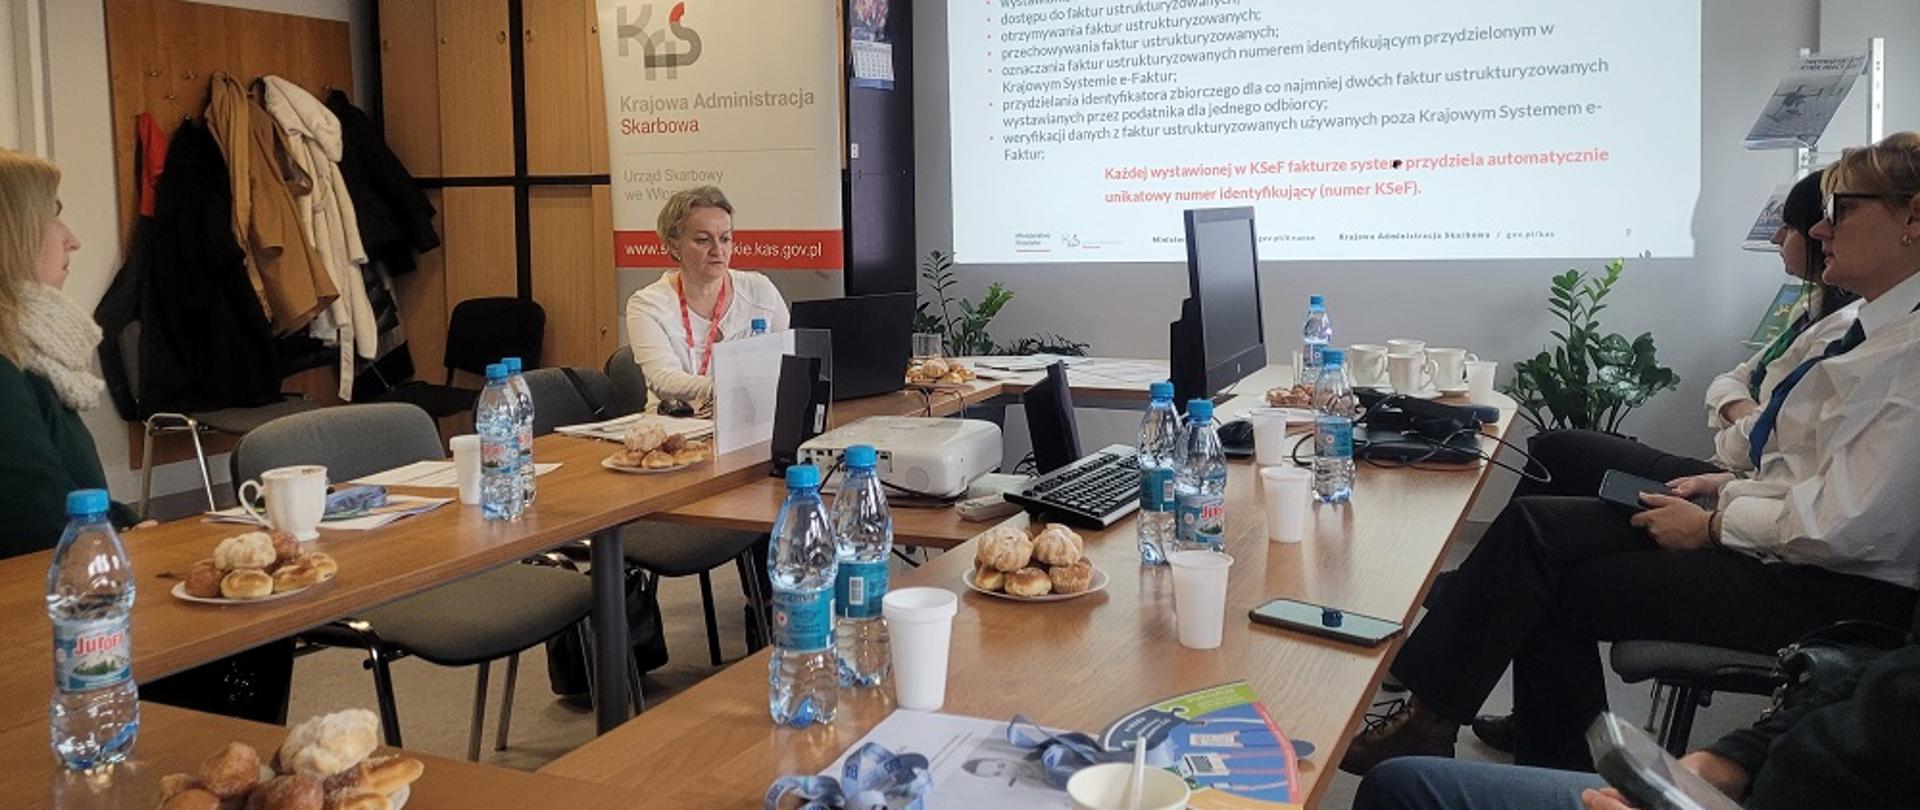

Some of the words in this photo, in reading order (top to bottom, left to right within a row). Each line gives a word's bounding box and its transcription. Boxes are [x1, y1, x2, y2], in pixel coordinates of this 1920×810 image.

[1049, 9, 1064, 21] do
[1067, 5, 1104, 19] faktur
[1106, 0, 1240, 16] ustrukturyzowanych;
[1001, 24, 1082, 43] otrzymywania
[1085, 21, 1121, 35] faktur
[1125, 8, 1261, 31] ustrukturyzowanych;
[1001, 40, 1100, 62] przechowywania
[1102, 37, 1137, 51] faktur
[1141, 26, 1279, 48] ustrukturyzowanych;
[1001, 60, 1065, 76] oznaczania
[1067, 57, 1104, 71] faktur
[1106, 46, 1236, 68] ustrukturyzowanych
[1239, 45, 1303, 58] numerem
[1307, 35, 1421, 54] identyfikującym
[1424, 27, 1536, 48] przydzielonym
[1540, 26, 1555, 35] w
[1003, 79, 1061, 95] Krajowym
[1064, 73, 1117, 92] Systemie
[1120, 70, 1177, 85] e-Faktur;
[1003, 94, 1078, 114] przydzielania
[1081, 89, 1167, 107] identyfikatora
[1170, 86, 1240, 100] zbiorczego
[1243, 82, 1262, 95] dla
[1265, 84, 1281, 94] co
[1284, 77, 1342, 95] najmniej
[1345, 74, 1393, 88] dwóch
[1396, 72, 1441, 85] faktur
[1445, 58, 1609, 82] ustrukturyzowanych
[620, 95, 689, 115] Krajowa
[693, 88, 815, 110] Administracja
[620, 117, 699, 135] Skarbowa
[1003, 110, 1084, 129] wystawianych
[1087, 111, 1119, 125] przez
[1122, 105, 1184, 124] podatnika
[1187, 104, 1206, 117] dla
[1208, 103, 1261, 119] jednego
[1003, 128, 1065, 146] weryfikacji
[1068, 126, 1110, 142] danych
[1113, 128, 1120, 138] z
[1122, 124, 1160, 137] faktur
[1163, 117, 1297, 136] ustrukturyzowanych
[1300, 113, 1377, 131] używanych
[1381, 114, 1415, 128] poza
[1419, 109, 1496, 125] Krajowym
[1500, 104, 1582, 121] Systemem
[623, 168, 662, 185] Urząd
[664, 168, 724, 183] Skarbowy
[1105, 165, 1147, 182] Każdej
[1150, 162, 1232, 182] wystawionej
[1235, 164, 1247, 175] w
[1250, 160, 1284, 174] KSeF
[1288, 159, 1346, 173] fakturze
[1406, 153, 1484, 172] przydziela
[1487, 148, 1609, 167] automatycznie
[1105, 188, 1174, 205] unikatowy
[1175, 190, 1216, 201] numer
[1220, 184, 1317, 203] identyfikujący
[1320, 183, 1371, 201] (numer
